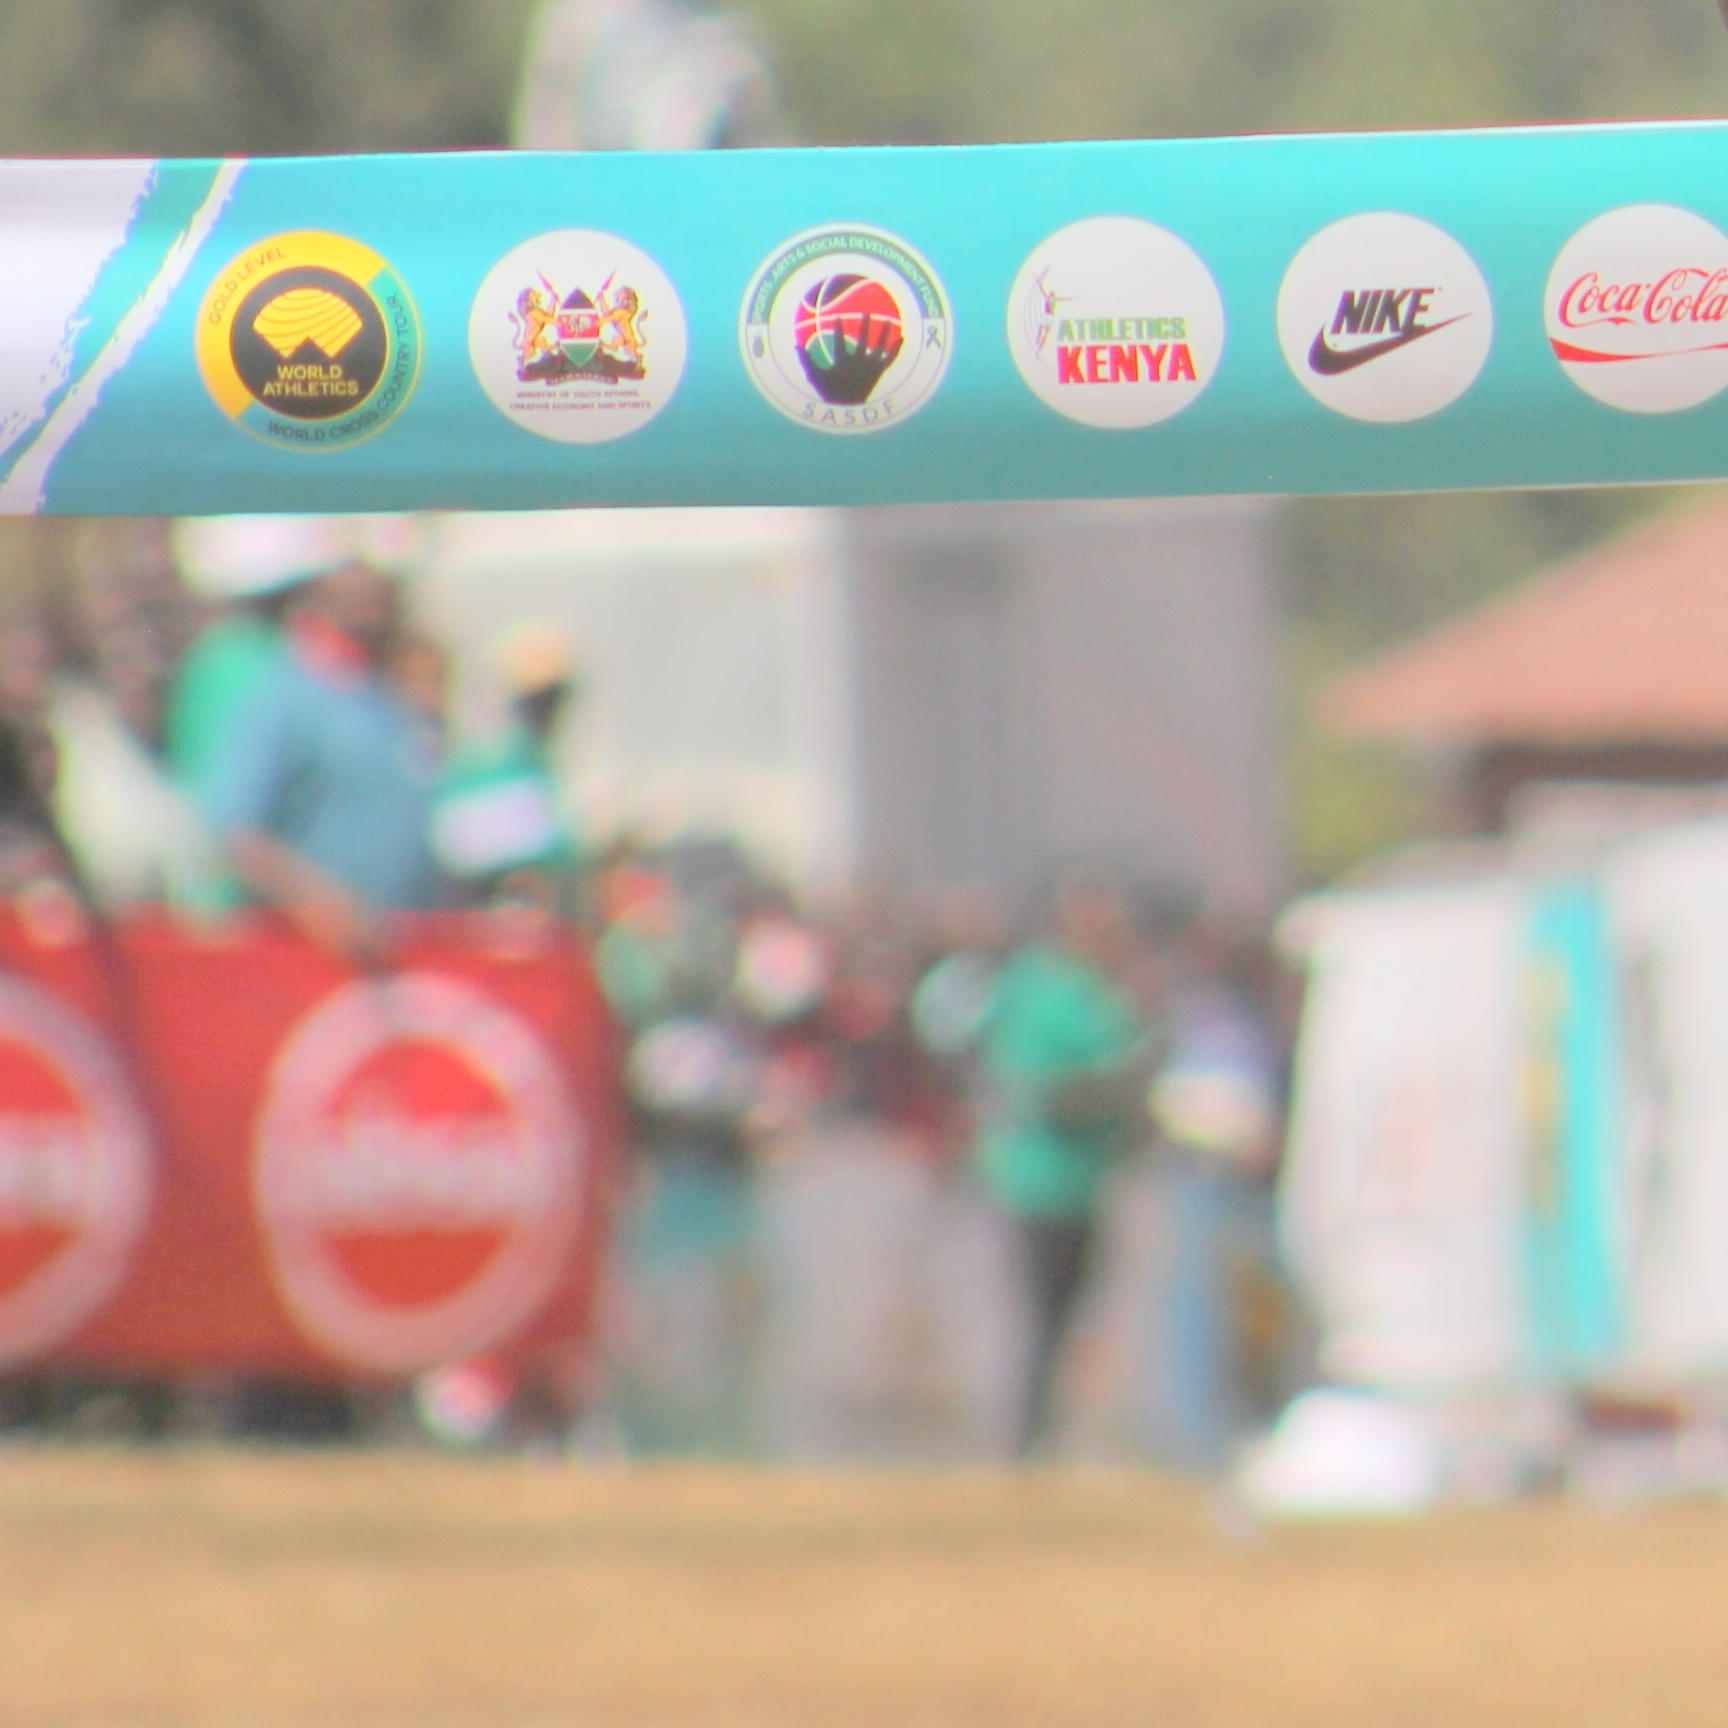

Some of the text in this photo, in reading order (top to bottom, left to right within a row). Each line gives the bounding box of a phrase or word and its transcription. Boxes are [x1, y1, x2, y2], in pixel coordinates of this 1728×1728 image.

[804, 235, 849, 255] SOCIAL
[208, 246, 288, 326] GOLD LEVEL
[1330, 287, 1435, 336] NIKE
[1057, 317, 1186, 341] ATHLETICS
[268, 420, 326, 441] WORLD
[329, 409, 380, 440] CROSS
[386, 292, 409, 337] TOUR
[276, 364, 343, 380] WORLD
[1057, 343, 1197, 384] KENYA
[262, 379, 360, 397] ATHLETICS
[802, 399, 895, 424] SASDF
